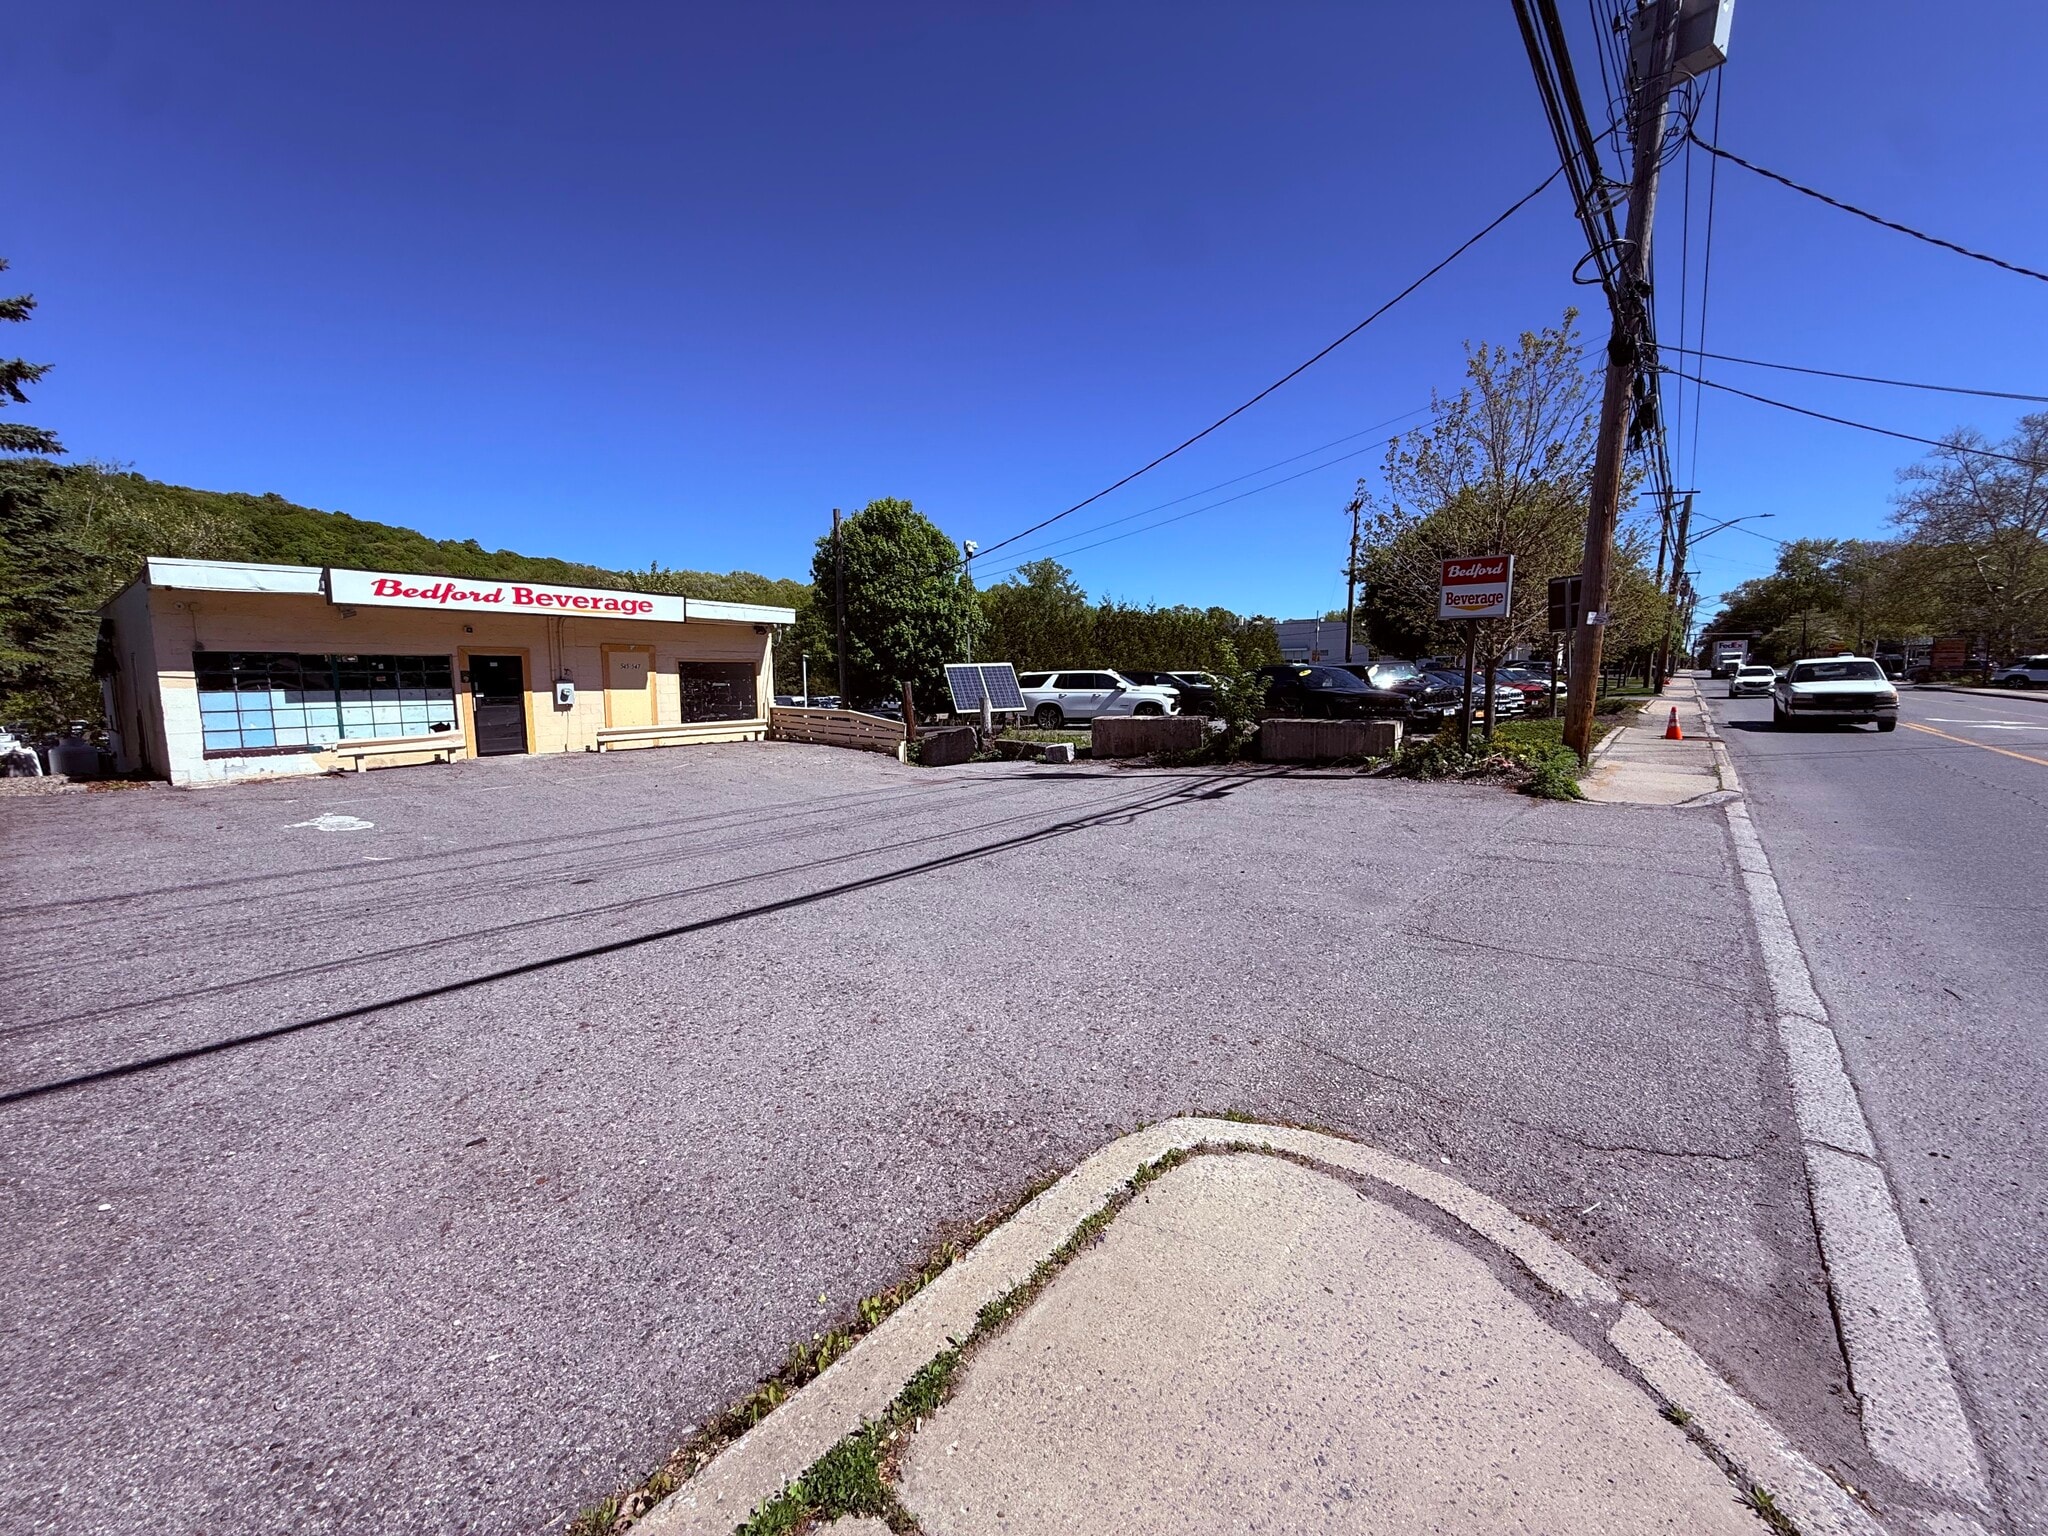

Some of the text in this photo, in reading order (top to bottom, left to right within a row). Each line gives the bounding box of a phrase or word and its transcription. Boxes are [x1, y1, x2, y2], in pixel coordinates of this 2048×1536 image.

[1447, 562, 1504, 578] Bedford
[371, 578, 654, 615] Bedford Beverage
[1445, 592, 1504, 607] Beverage
